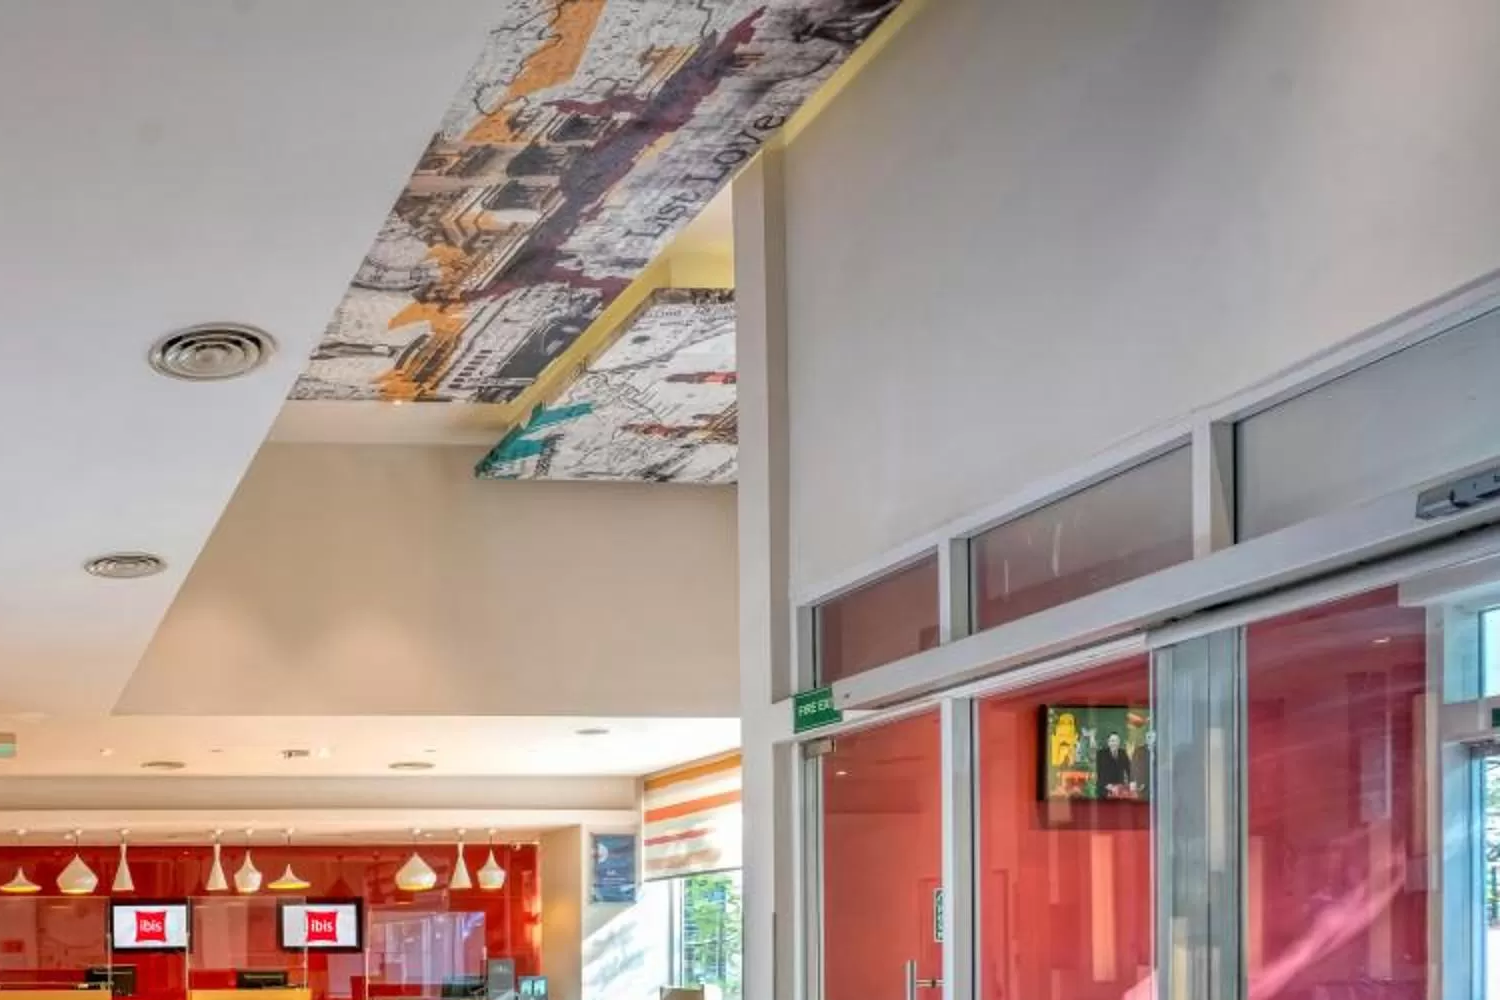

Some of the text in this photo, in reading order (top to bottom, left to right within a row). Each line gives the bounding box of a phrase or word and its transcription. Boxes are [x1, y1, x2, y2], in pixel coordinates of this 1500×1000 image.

[681, 114, 786, 187] Love
[798, 701, 817, 716] FIRE
[139, 919, 163, 933] ibis
[311, 919, 332, 932] ibis
